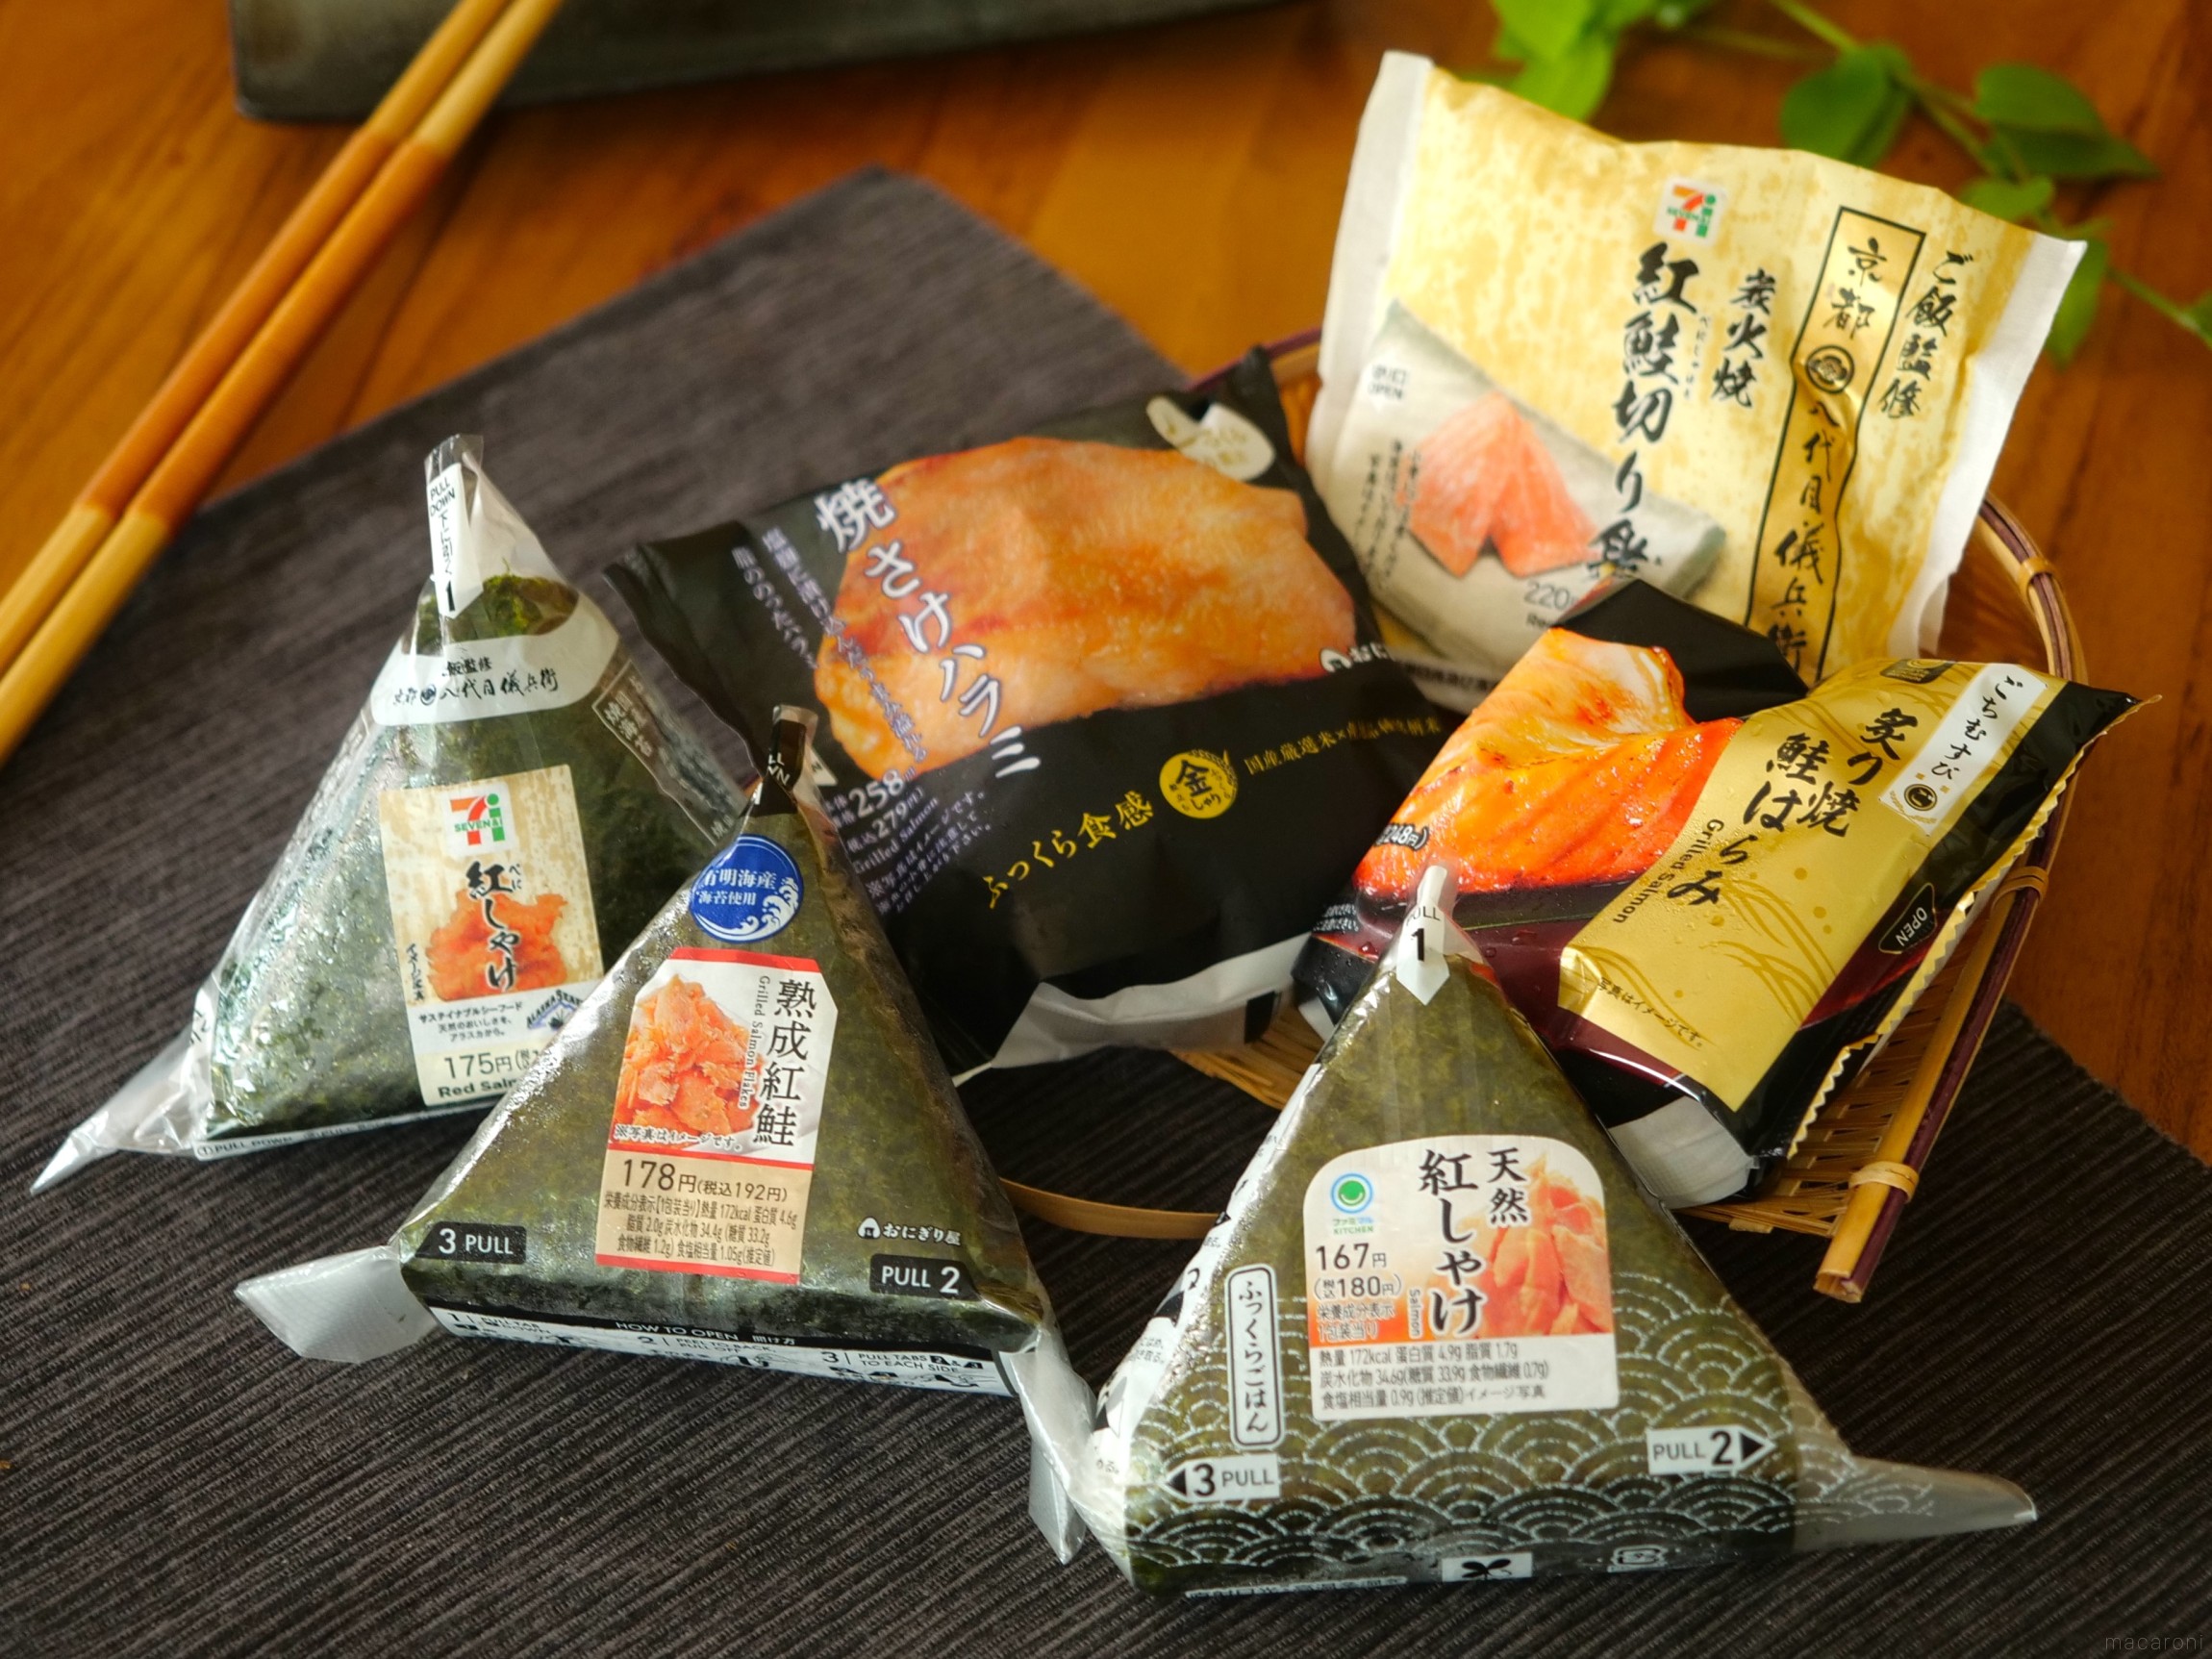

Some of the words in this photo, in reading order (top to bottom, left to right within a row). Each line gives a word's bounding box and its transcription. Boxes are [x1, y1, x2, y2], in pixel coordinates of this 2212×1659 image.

[1823, 238, 1887, 339] 京都
[1711, 268, 1775, 408] 炭火焼
[1880, 250, 1973, 419] ご飯監修
[429, 478, 451, 501] PULL
[429, 489, 457, 518] DOWN
[444, 580, 457, 612] 1
[814, 478, 1041, 778] 焼さけハラミ
[1931, 675, 2023, 780] ごちむすび
[1175, 760, 1212, 797] 金
[1797, 707, 1919, 838] 炙り焼
[899, 797, 940, 842] Salmon
[1667, 732, 1827, 906] 鮭はらみ
[982, 789, 1154, 909] ふっくら食感
[1671, 818, 1724, 870] Grilled
[1613, 872, 1675, 923] Salmon
[465, 861, 520, 992] 紅しゃけ
[1411, 928, 1425, 961] 1
[1894, 906, 1929, 948] OPEN
[751, 975, 771, 1018] Grilled
[744, 1019, 764, 1067] Salmon
[752, 978, 817, 1147] 熟成紅鮭
[437, 1082, 475, 1099] Red
[738, 1068, 757, 1108] Flakes
[1487, 1146, 1528, 1224] 天然
[439, 1228, 456, 1253] 3
[465, 1235, 514, 1255] PULL
[883, 1222, 961, 1246] おにぎり屋
[1333, 1226, 1374, 1235] KITCHEN
[1418, 1148, 1485, 1335] 紅しゃけ
[881, 1266, 931, 1288] PULL
[940, 1266, 960, 1294] 2
[616, 1321, 659, 1333] HOW
[664, 1325, 687, 1335] TO
[692, 1329, 739, 1341] OPEN
[1409, 1289, 1422, 1337] Salmon
[1237, 1279, 1270, 1433] ふっくらごはん
[1349, 1347, 1392, 1366] 172kcal
[1653, 1441, 1706, 1461] PULL
[1711, 1429, 1732, 1467] 2
[1193, 1462, 1216, 1496] 3
[1221, 1463, 1275, 1486] PULL
